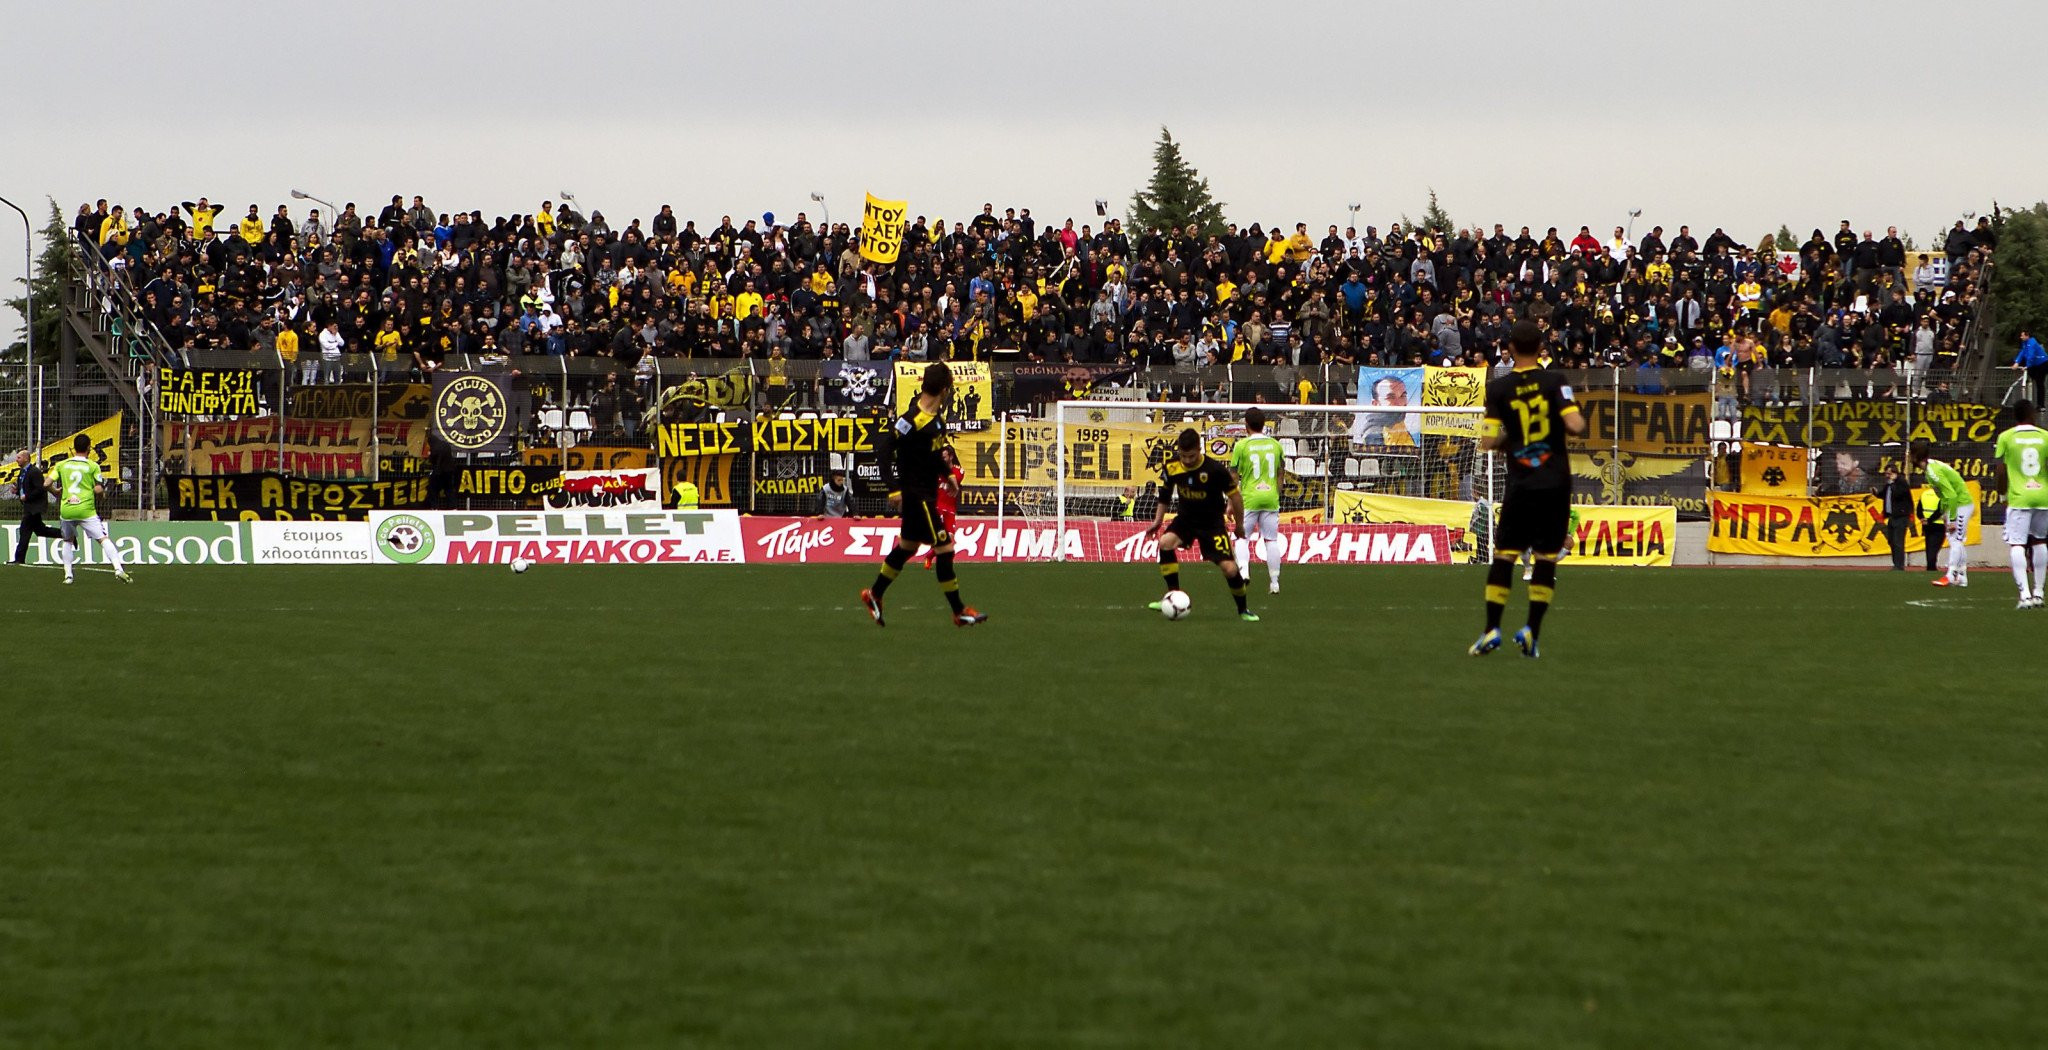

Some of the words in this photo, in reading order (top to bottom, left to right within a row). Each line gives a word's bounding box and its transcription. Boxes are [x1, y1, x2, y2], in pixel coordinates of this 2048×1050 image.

[454, 380, 489, 393] CLUB
[160, 391, 256, 414] ΟΙΝΟΦΥΤΑ
[440, 407, 448, 417] 9
[492, 408, 503, 418] 11
[1510, 394, 1551, 446] 13
[450, 429, 492, 444] GETTO
[658, 422, 741, 457] ΝΕΟΣ
[752, 418, 873, 452] ΚΟΣΜΟΣ
[1007, 427, 1058, 441] SINC
[1077, 429, 1109, 442] 1989
[1743, 420, 1996, 447] ΜΟΣΧΑΤΟ
[802, 456, 815, 476] 11
[975, 442, 1132, 481] KIPSELI
[1250, 453, 1276, 480] 11
[2021, 447, 2041, 476] 8
[69, 471, 83, 494] 2
[178, 478, 238, 509] ΑΕΚ
[458, 469, 526, 495] ΑΙΓΙΟ
[443, 514, 714, 536] PELLET
[1713, 499, 1817, 543] ΜΠΡΑ
[283, 529, 343, 546] έτοιμος
[757, 521, 835, 563] Πάμε
[843, 523, 1085, 558] ΣΤΧΗΜΑ
[1214, 535, 1229, 550] 21
[1226, 528, 1437, 564] ΟΙΧΗΜΑ
[261, 546, 368, 563] χλοοτάπητας
[446, 540, 691, 564] ΜΠΑΣΙΑΚΟΣ
[694, 549, 736, 564] Α.Ε.
